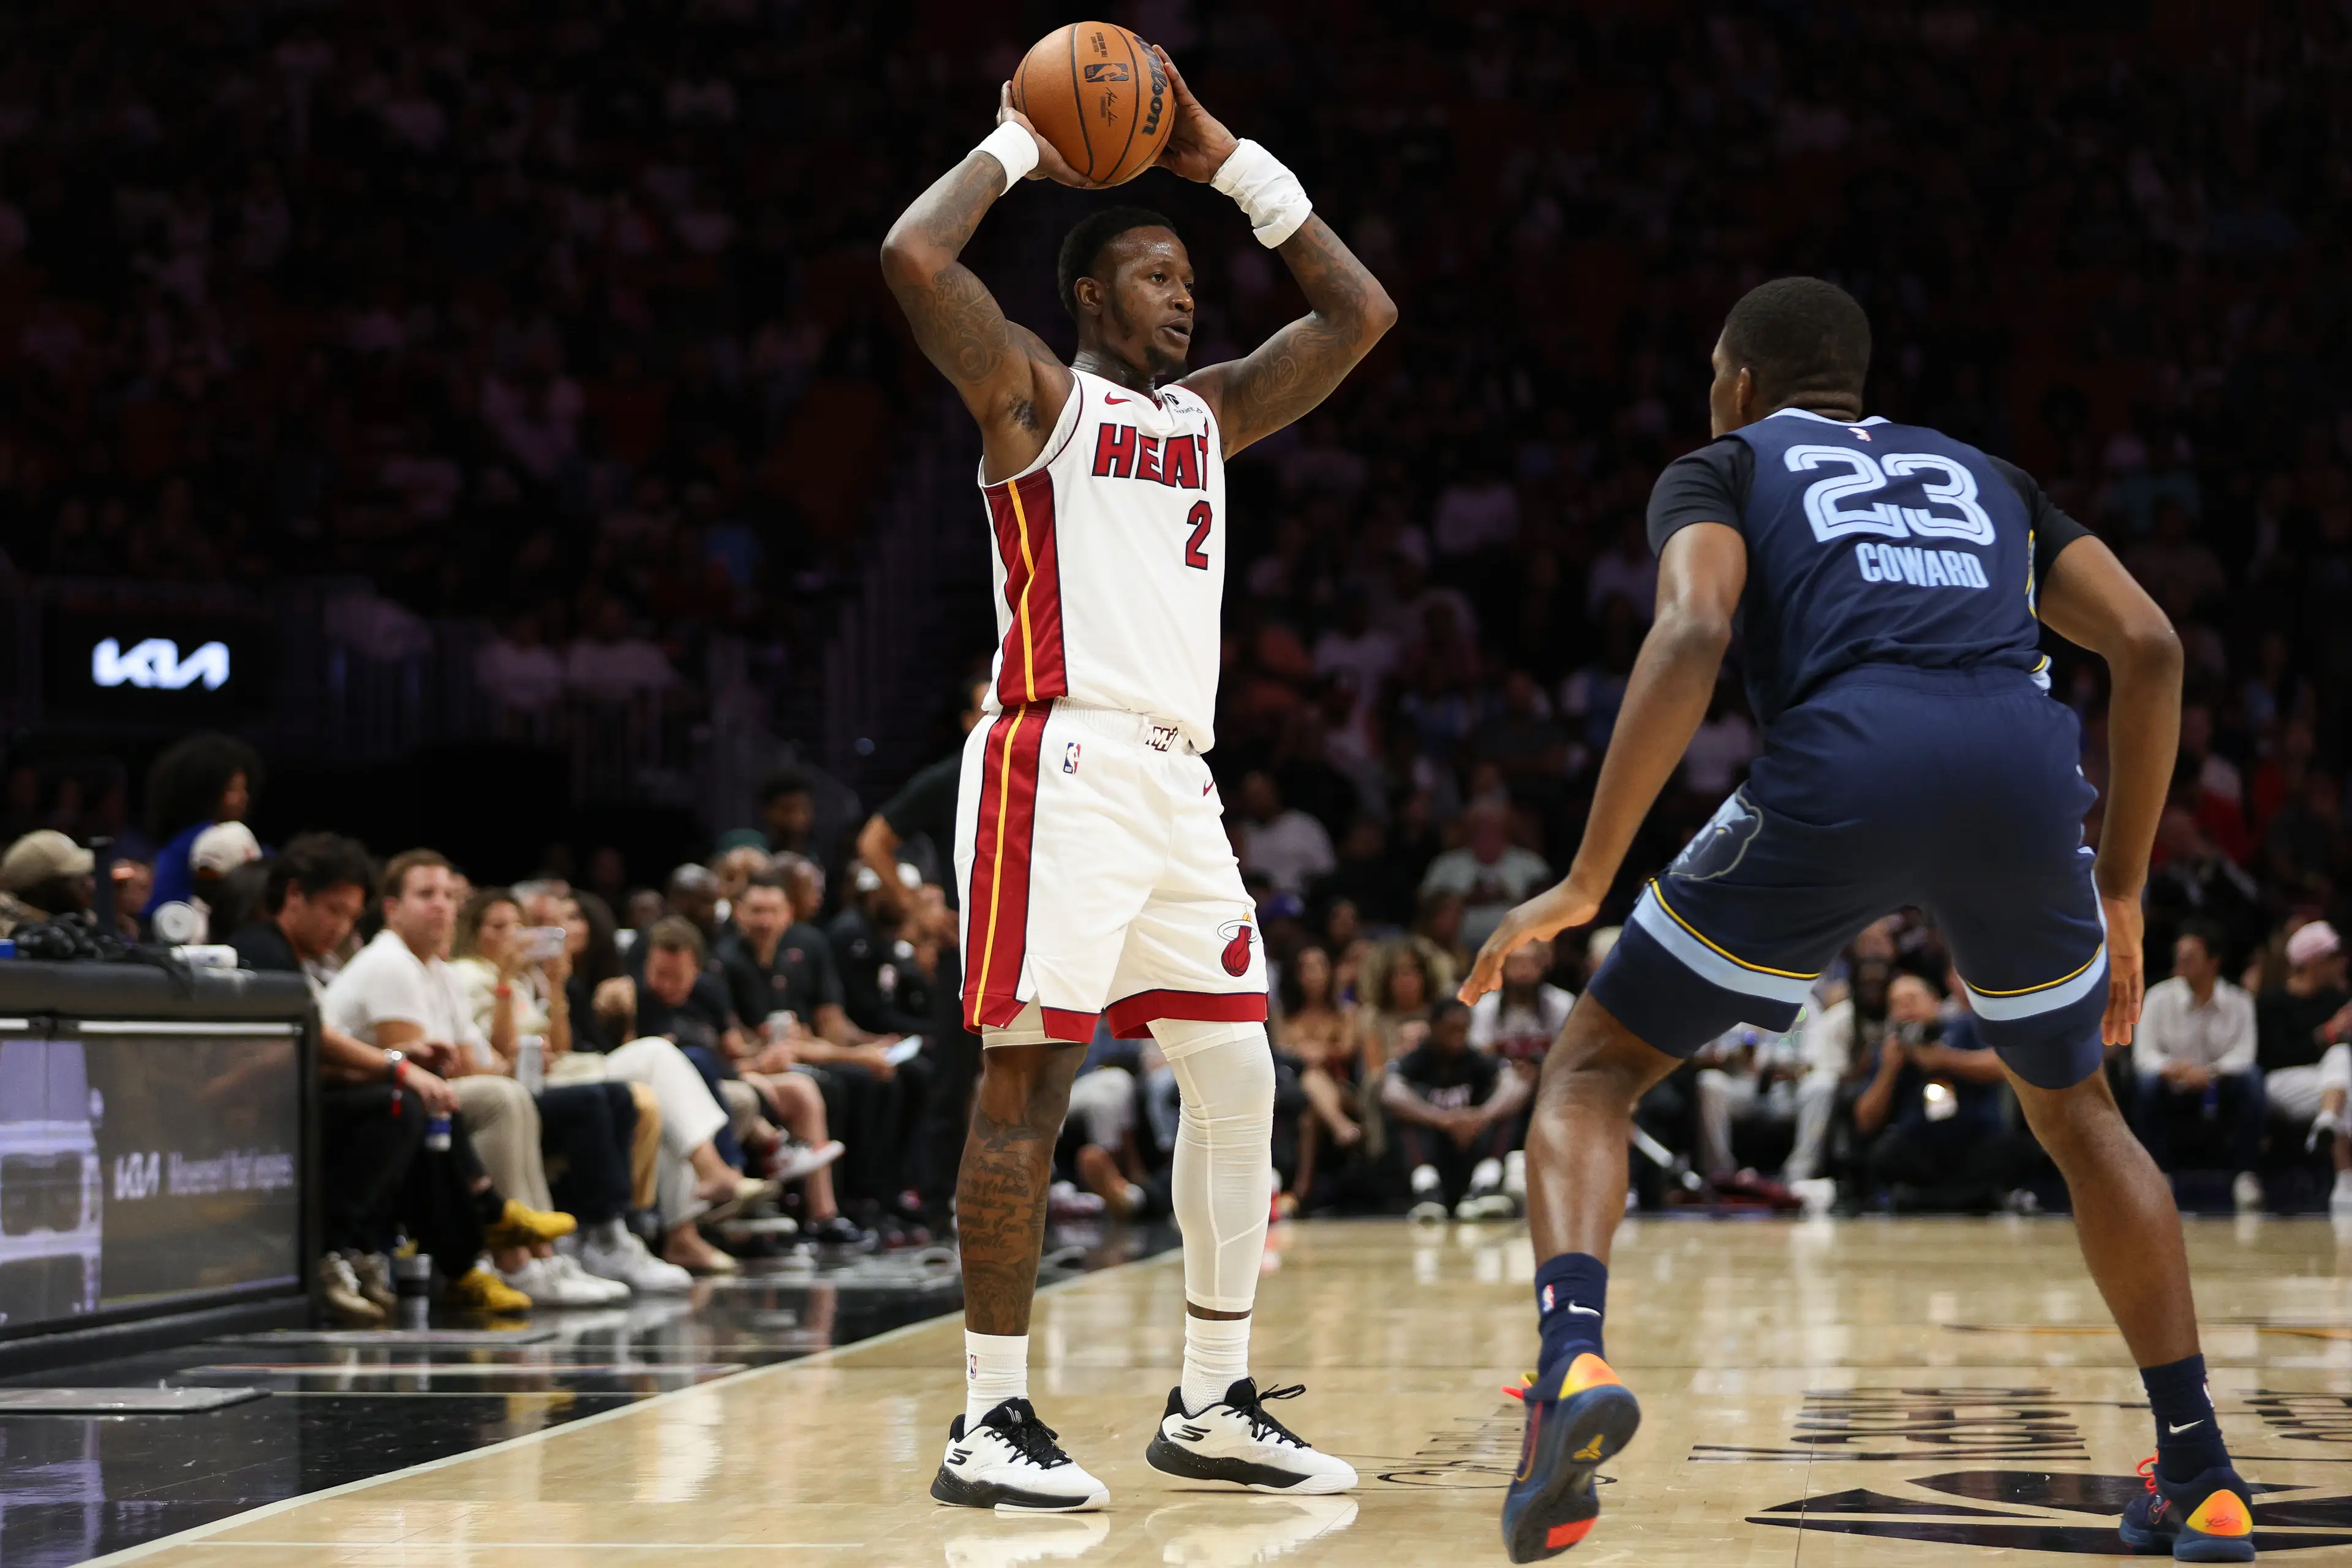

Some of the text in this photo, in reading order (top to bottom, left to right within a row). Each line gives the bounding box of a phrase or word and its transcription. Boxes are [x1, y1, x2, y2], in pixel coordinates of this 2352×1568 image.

[1091, 417, 1209, 492] HEAT
[1784, 444, 1996, 546] 23
[1186, 500, 1213, 571] 2
[1855, 543, 1989, 589] COWARD
